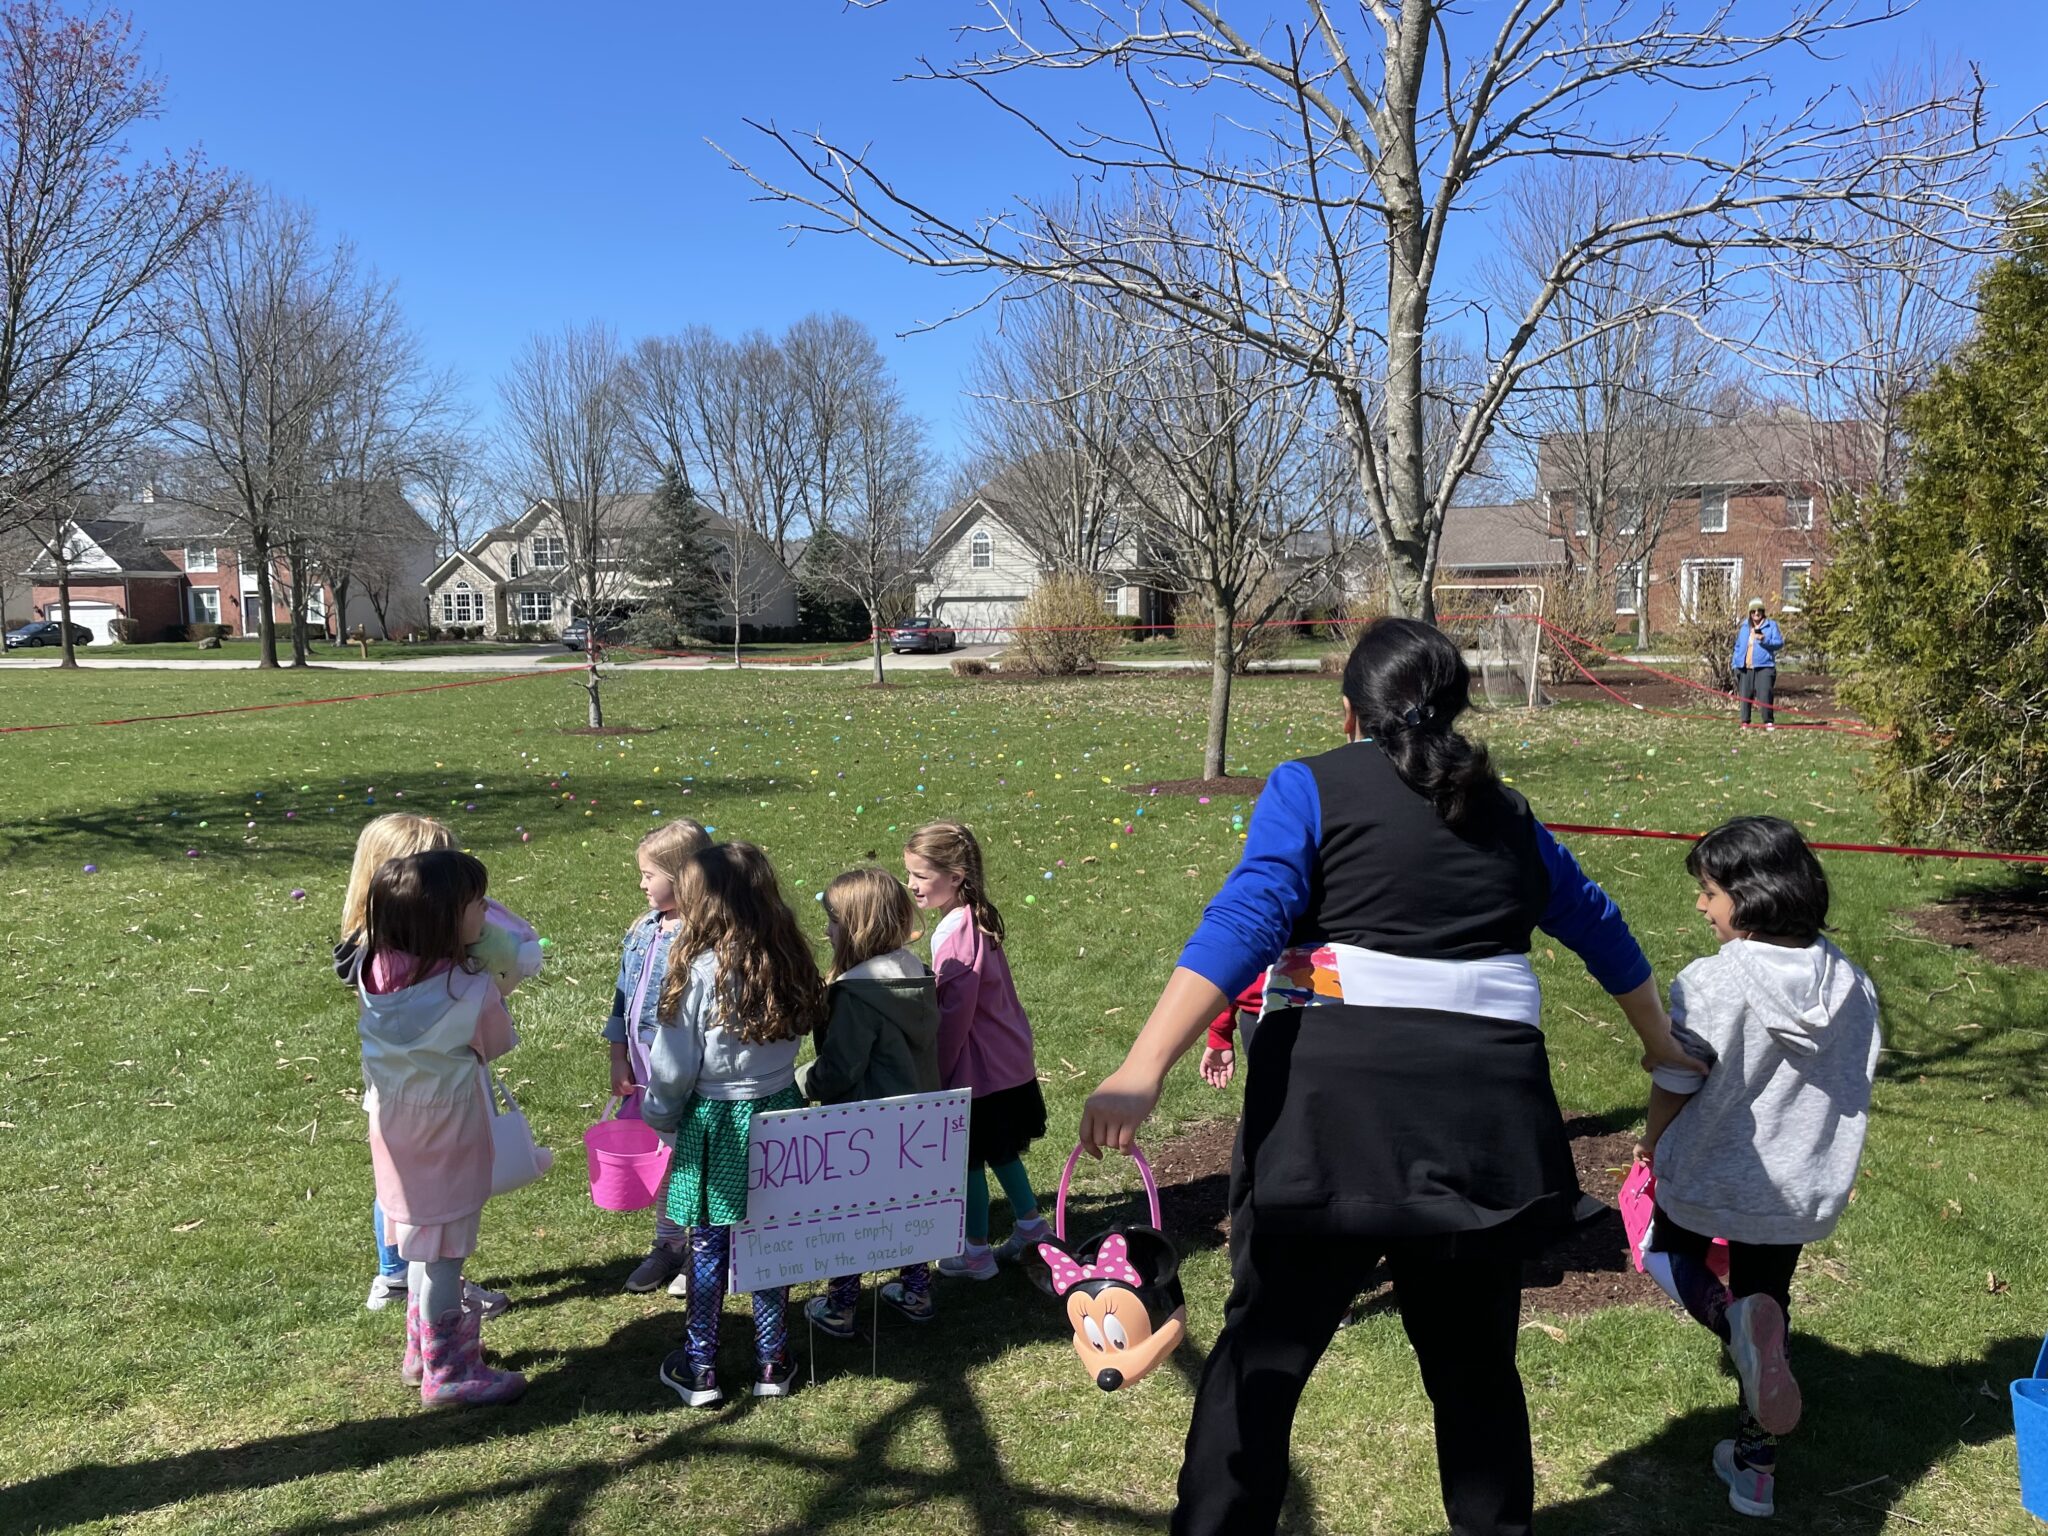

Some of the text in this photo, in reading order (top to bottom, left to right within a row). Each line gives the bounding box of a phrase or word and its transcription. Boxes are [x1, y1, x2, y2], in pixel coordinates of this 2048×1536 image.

[748, 1128, 874, 1190] GRADES
[748, 1217, 935, 1257] Please return empty eggs
[756, 1243, 914, 1281] to bins by the gazebo
